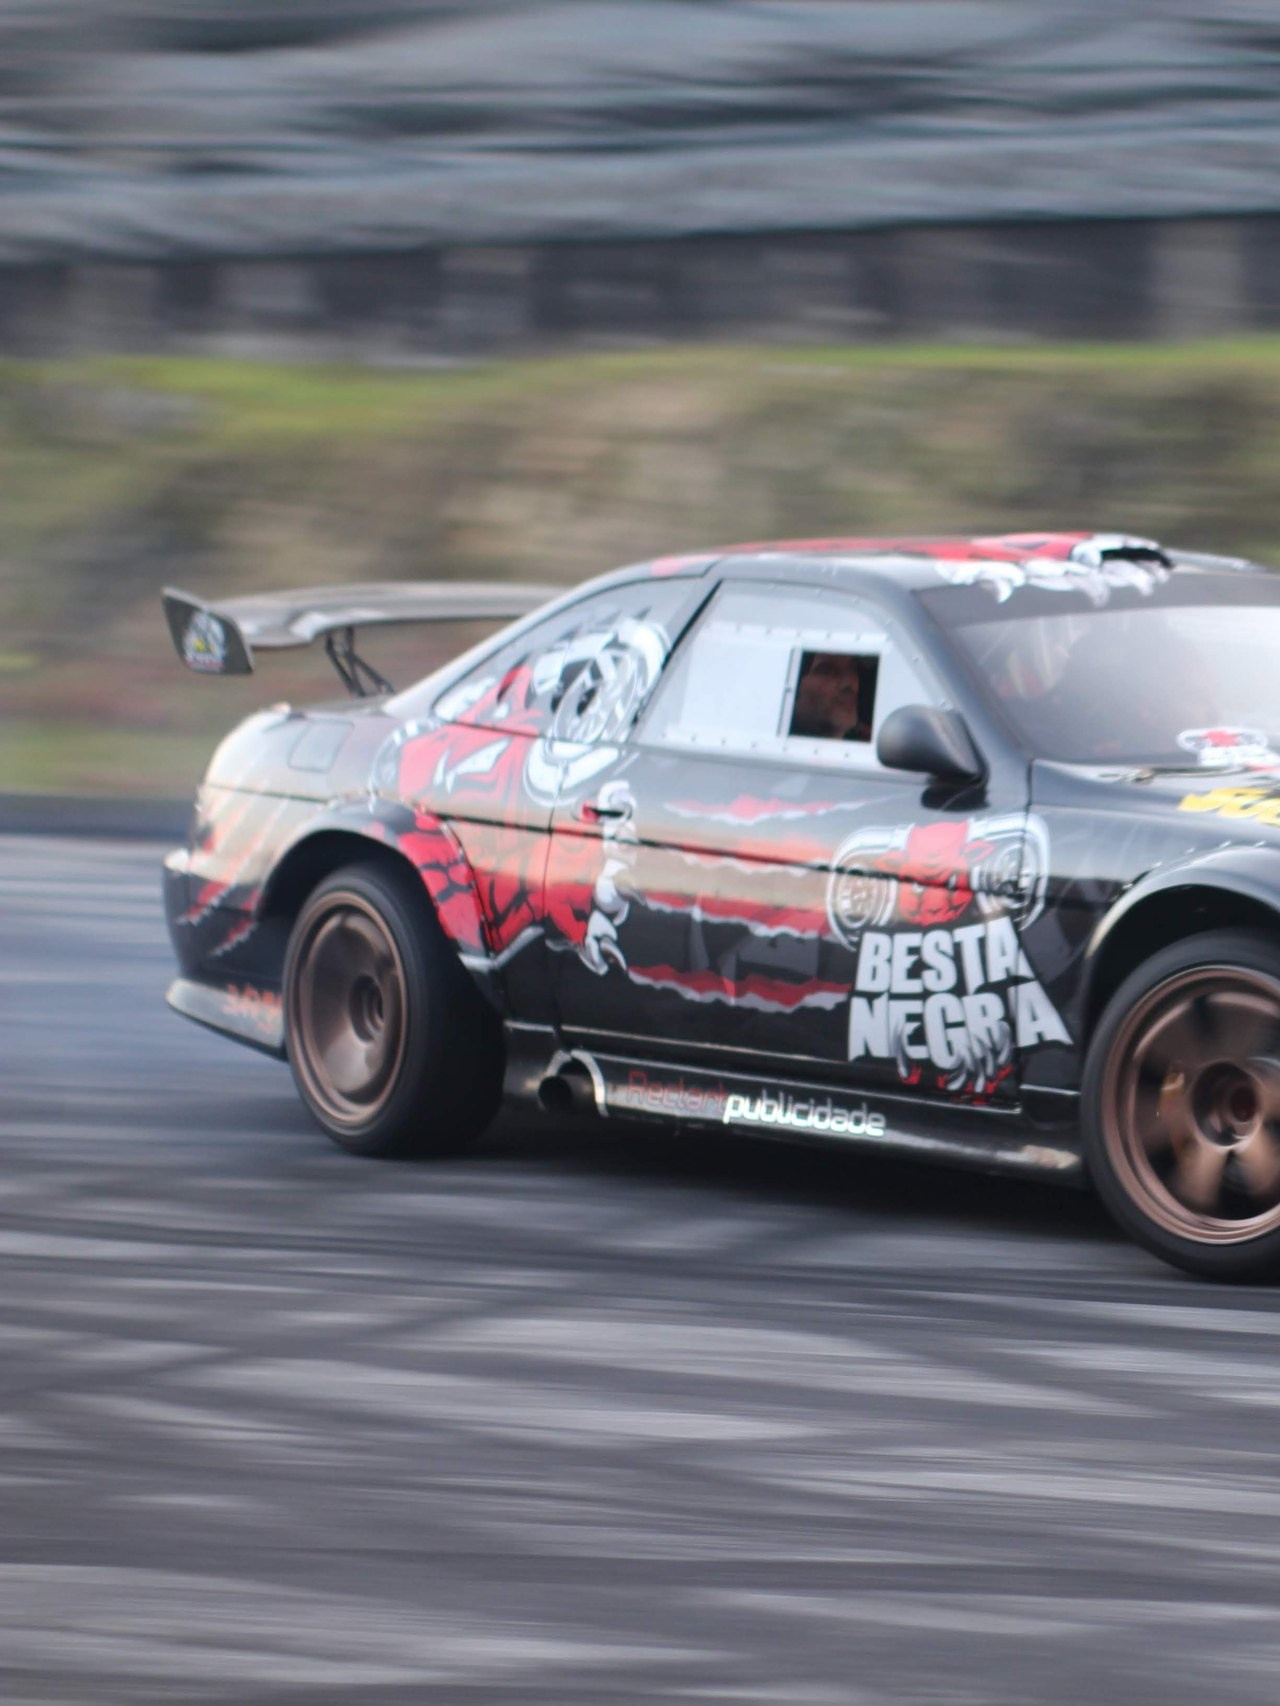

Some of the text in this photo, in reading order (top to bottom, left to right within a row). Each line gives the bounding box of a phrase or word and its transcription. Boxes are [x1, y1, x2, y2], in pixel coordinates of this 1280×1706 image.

[855, 916, 1036, 995] BESTA
[848, 980, 1074, 1070] NEGRA
[723, 1088, 886, 1137] publicidade
